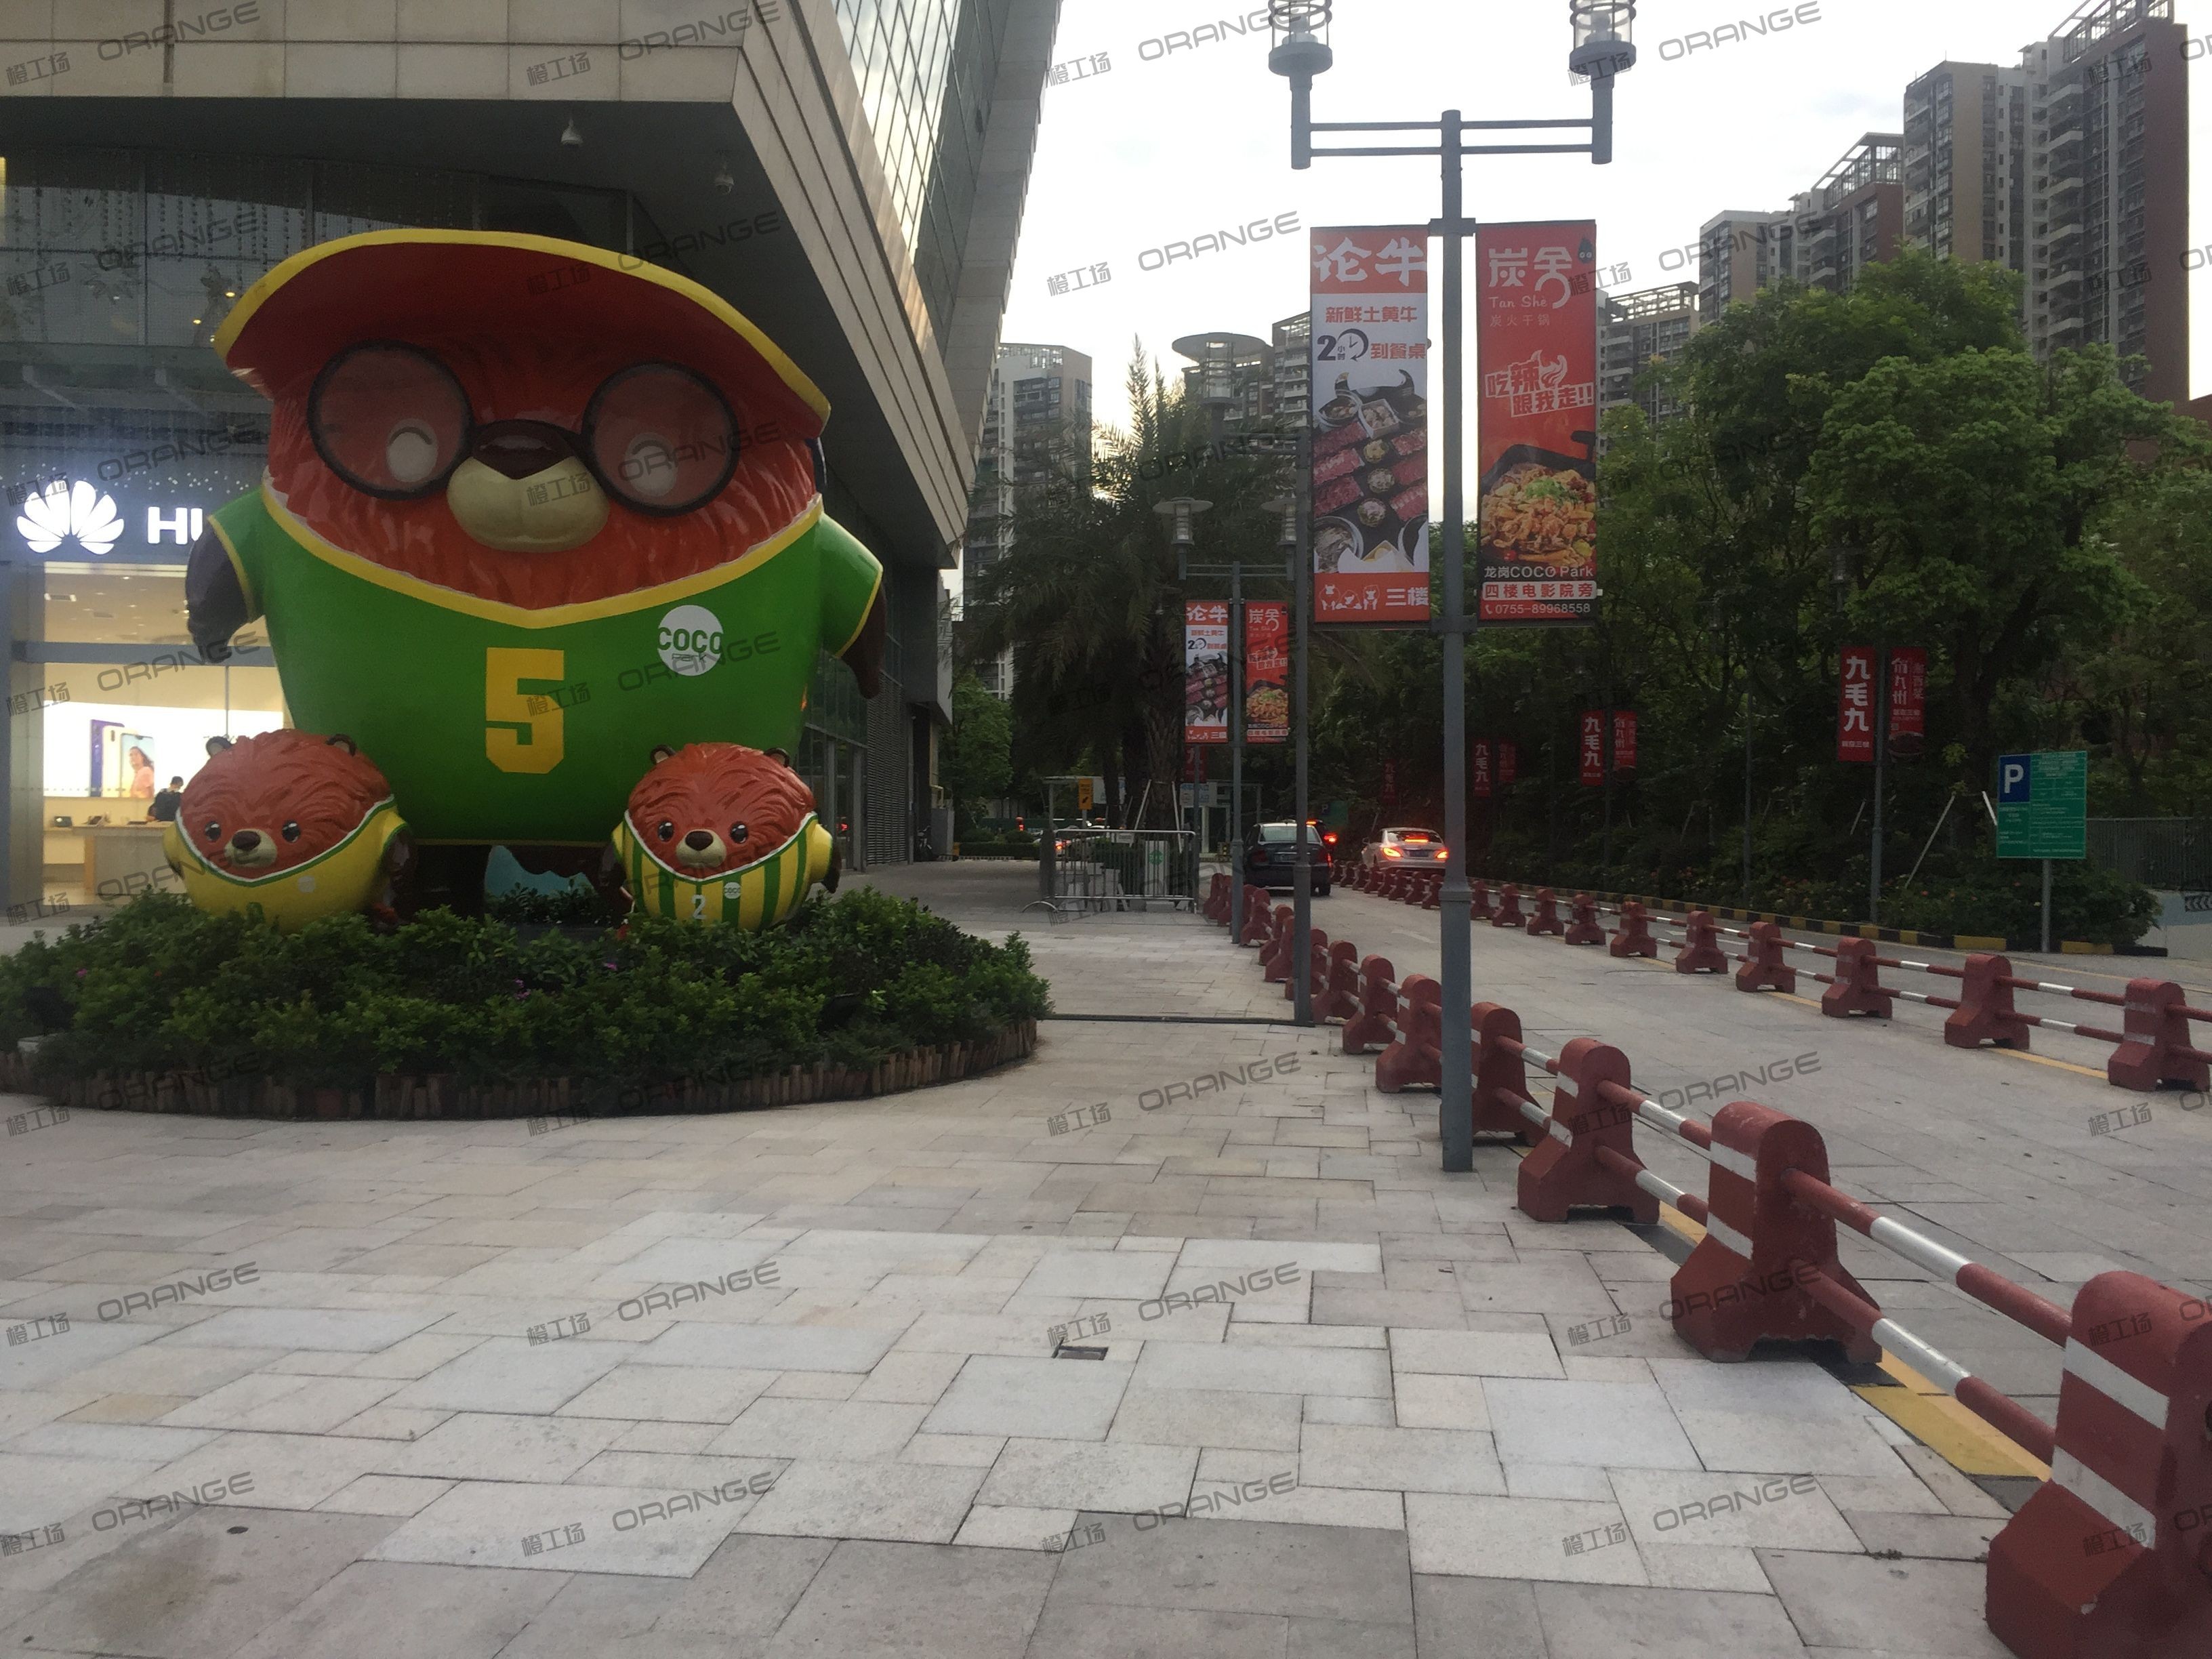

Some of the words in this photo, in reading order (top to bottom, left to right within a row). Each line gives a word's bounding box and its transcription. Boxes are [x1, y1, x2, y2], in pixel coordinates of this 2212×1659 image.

[1313, 237, 1427, 287] 论牛
[1326, 306, 1417, 323] 新鲜土黄牛
[1488, 296, 1515, 308] Tan
[1490, 313, 1551, 327] 炭火干锅
[1317, 335, 1337, 361] 2
[1370, 343, 1427, 359] 到餐桌
[1560, 565, 1593, 577] Park
[1385, 586, 1429, 607] 三楼
[1485, 583, 1593, 598] 四楼电影院旁
[1186, 605, 1228, 623] 论牛
[657, 627, 724, 654] COCO
[1843, 656, 1870, 731] 九毛九
[485, 647, 564, 774] 5
[1584, 716, 1601, 767] 九毛九
[1475, 743, 1489, 782] 九毛九
[2004, 764, 2024, 794] P
[691, 895, 706, 920] 2
